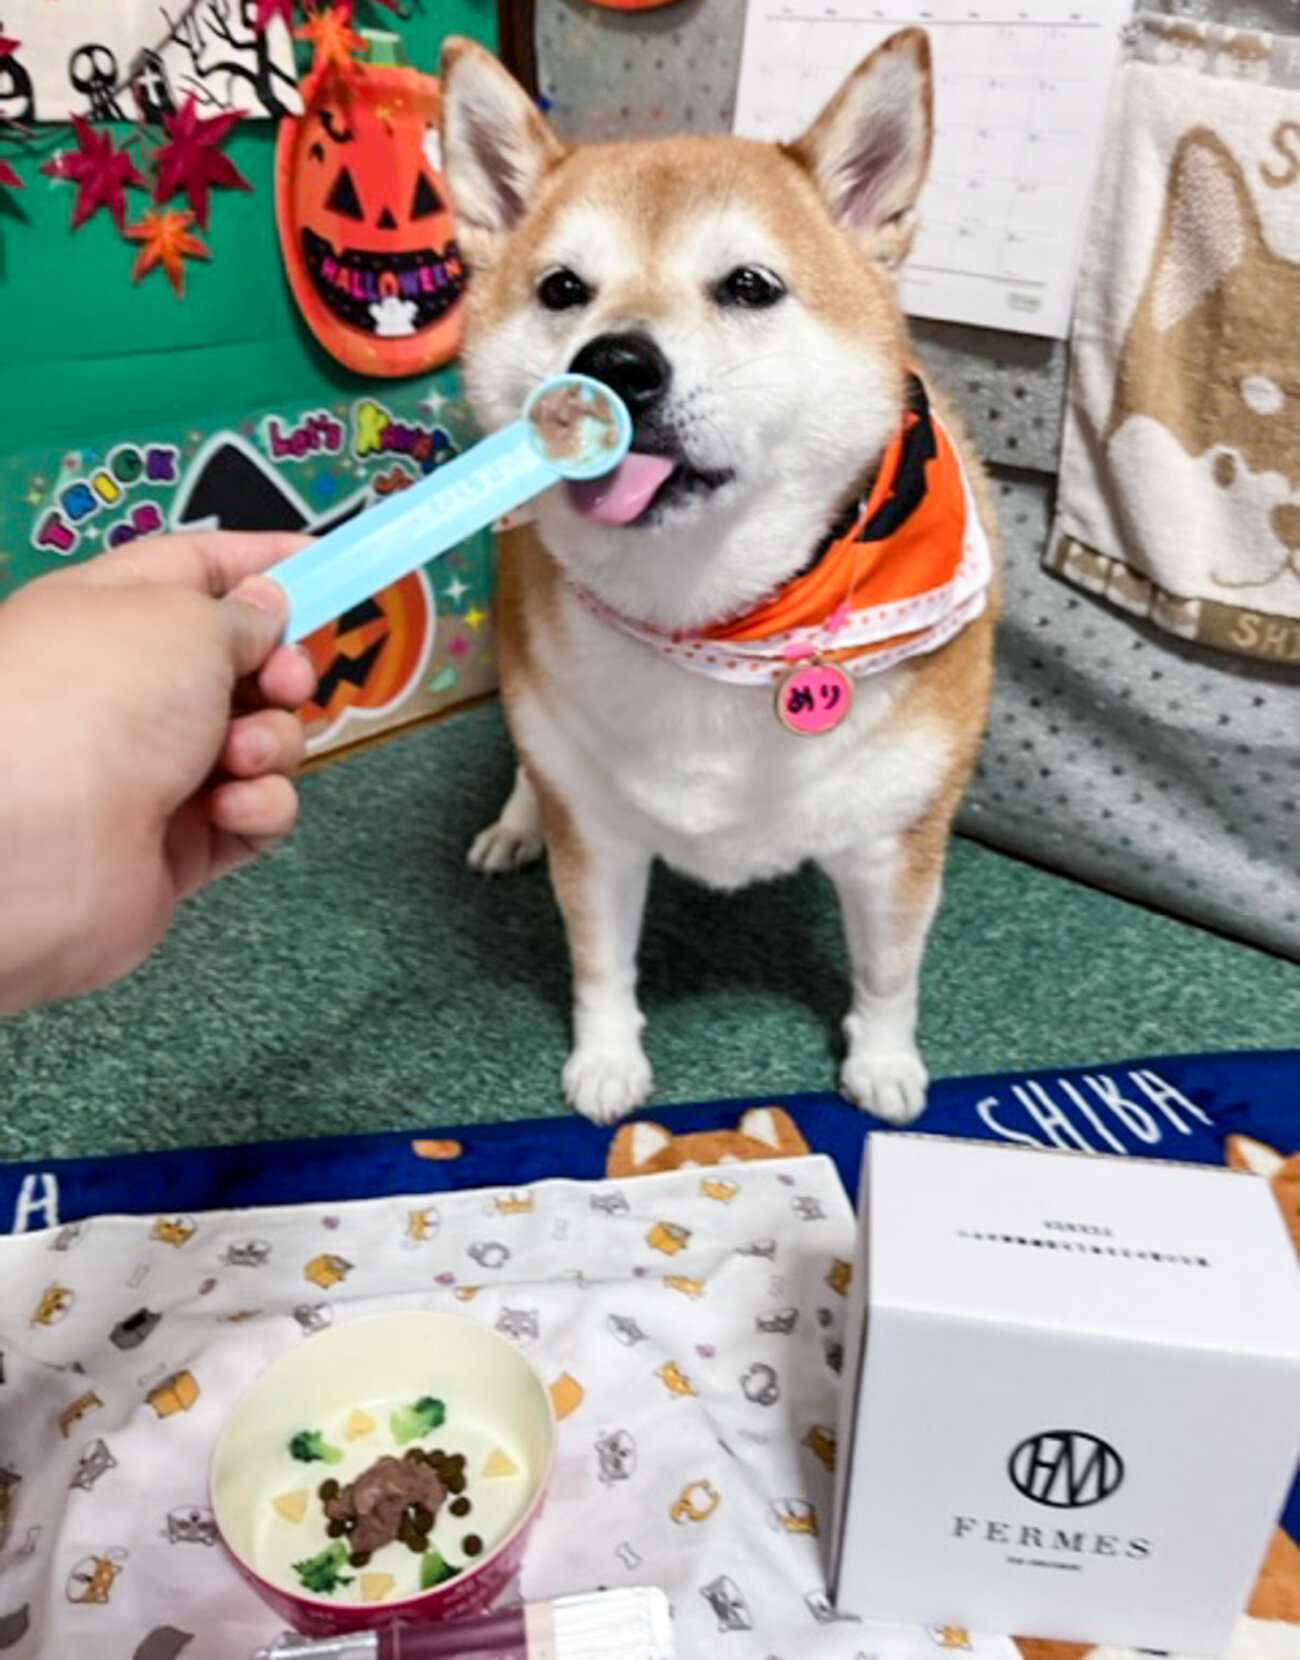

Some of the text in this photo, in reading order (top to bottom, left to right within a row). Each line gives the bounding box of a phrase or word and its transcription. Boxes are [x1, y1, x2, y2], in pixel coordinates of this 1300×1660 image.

[320, 256, 462, 302] HALLOWEEN
[37, 448, 176, 551] TRICK
[975, 1068, 1214, 1154] SHIBA
[952, 1514, 1153, 1561] FERMES
